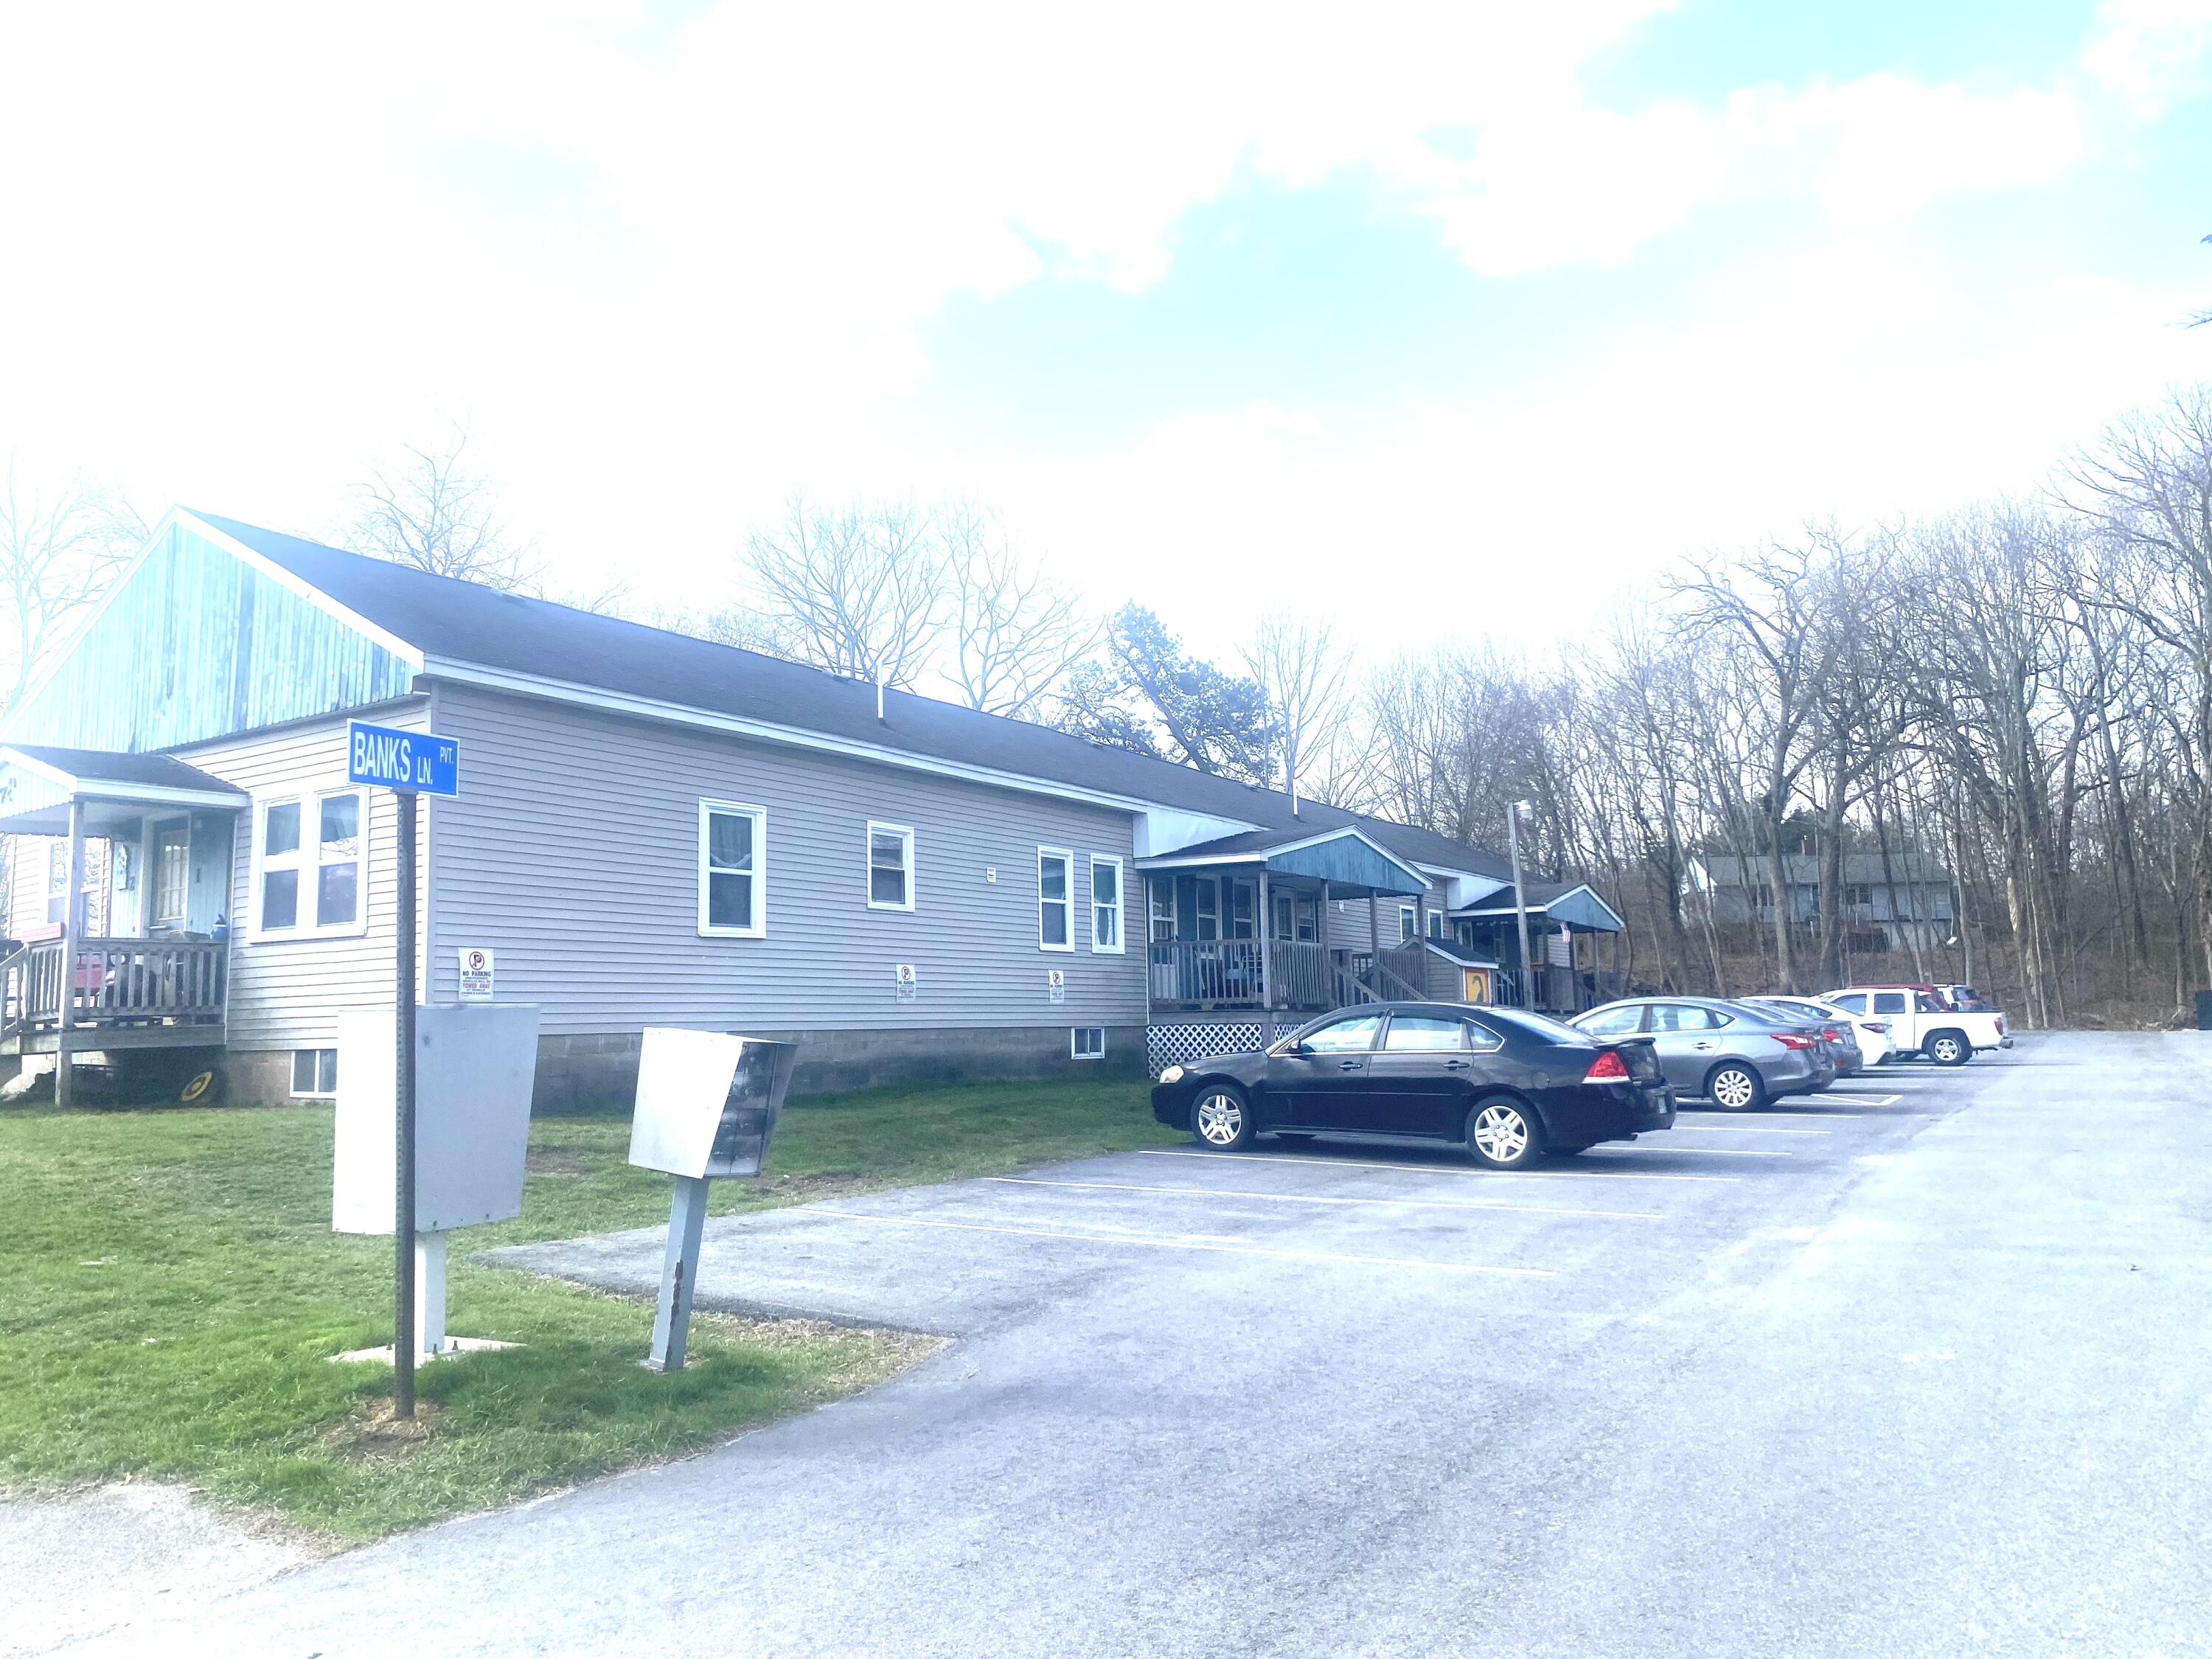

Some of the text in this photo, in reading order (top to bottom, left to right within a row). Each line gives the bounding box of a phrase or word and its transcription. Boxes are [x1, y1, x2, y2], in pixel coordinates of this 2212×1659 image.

[354, 731, 434, 785] BANKS LN.
[439, 746, 454, 765] PVT.
[474, 955, 481, 967] P
